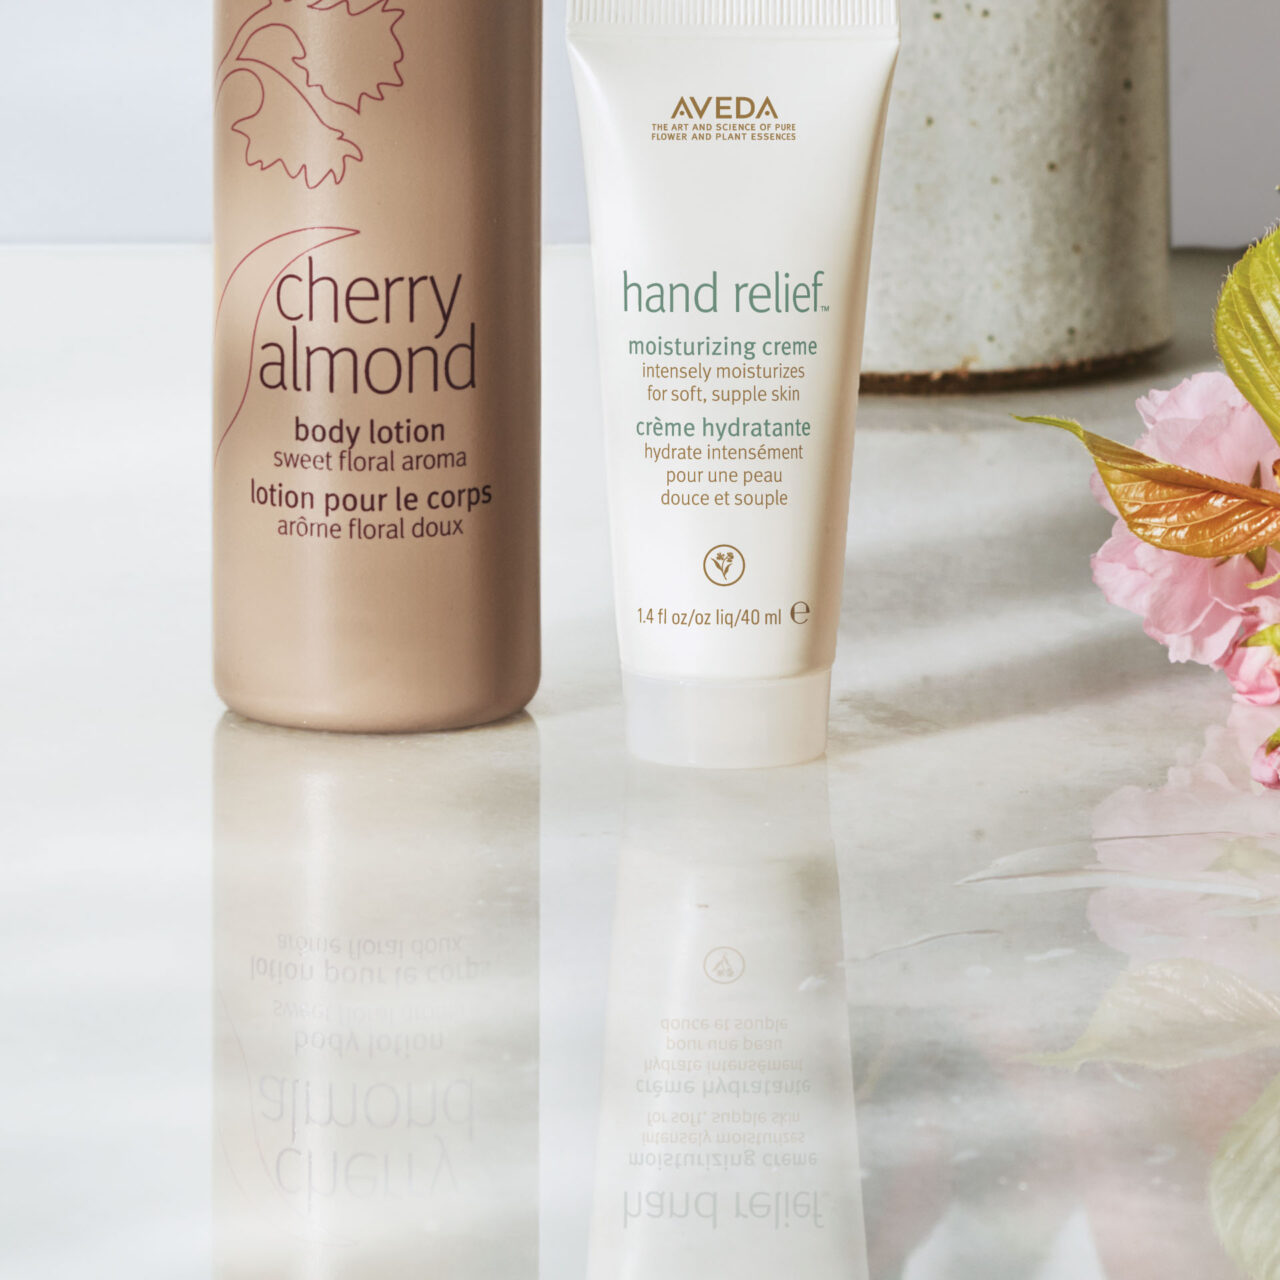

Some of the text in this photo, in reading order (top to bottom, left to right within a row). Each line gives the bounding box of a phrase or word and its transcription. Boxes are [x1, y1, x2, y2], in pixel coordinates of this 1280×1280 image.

[671, 96, 778, 119] AVEDA
[276, 255, 462, 339] cherry
[623, 270, 718, 313] hand
[259, 322, 476, 394] almond
[628, 336, 817, 360] moisturizing creme
[642, 362, 805, 382] intensely moisturizes
[648, 385, 800, 405] for soft, supple skin
[295, 416, 445, 448] body lotion
[636, 416, 810, 441] crème hydratante
[273, 449, 467, 472] sweet floral aroma
[644, 442, 803, 462] hydrate intensément
[666, 470, 782, 486] pour une peau
[251, 478, 492, 516] lotion pour le corps
[661, 490, 788, 509] douce et souple
[277, 516, 463, 540] arôme floral doux
[638, 608, 654, 624] 1.4
[658, 608, 666, 624] fl
[671, 609, 711, 626] oz/oz
[716, 608, 760, 628] liq/40
[765, 609, 782, 625] ml
